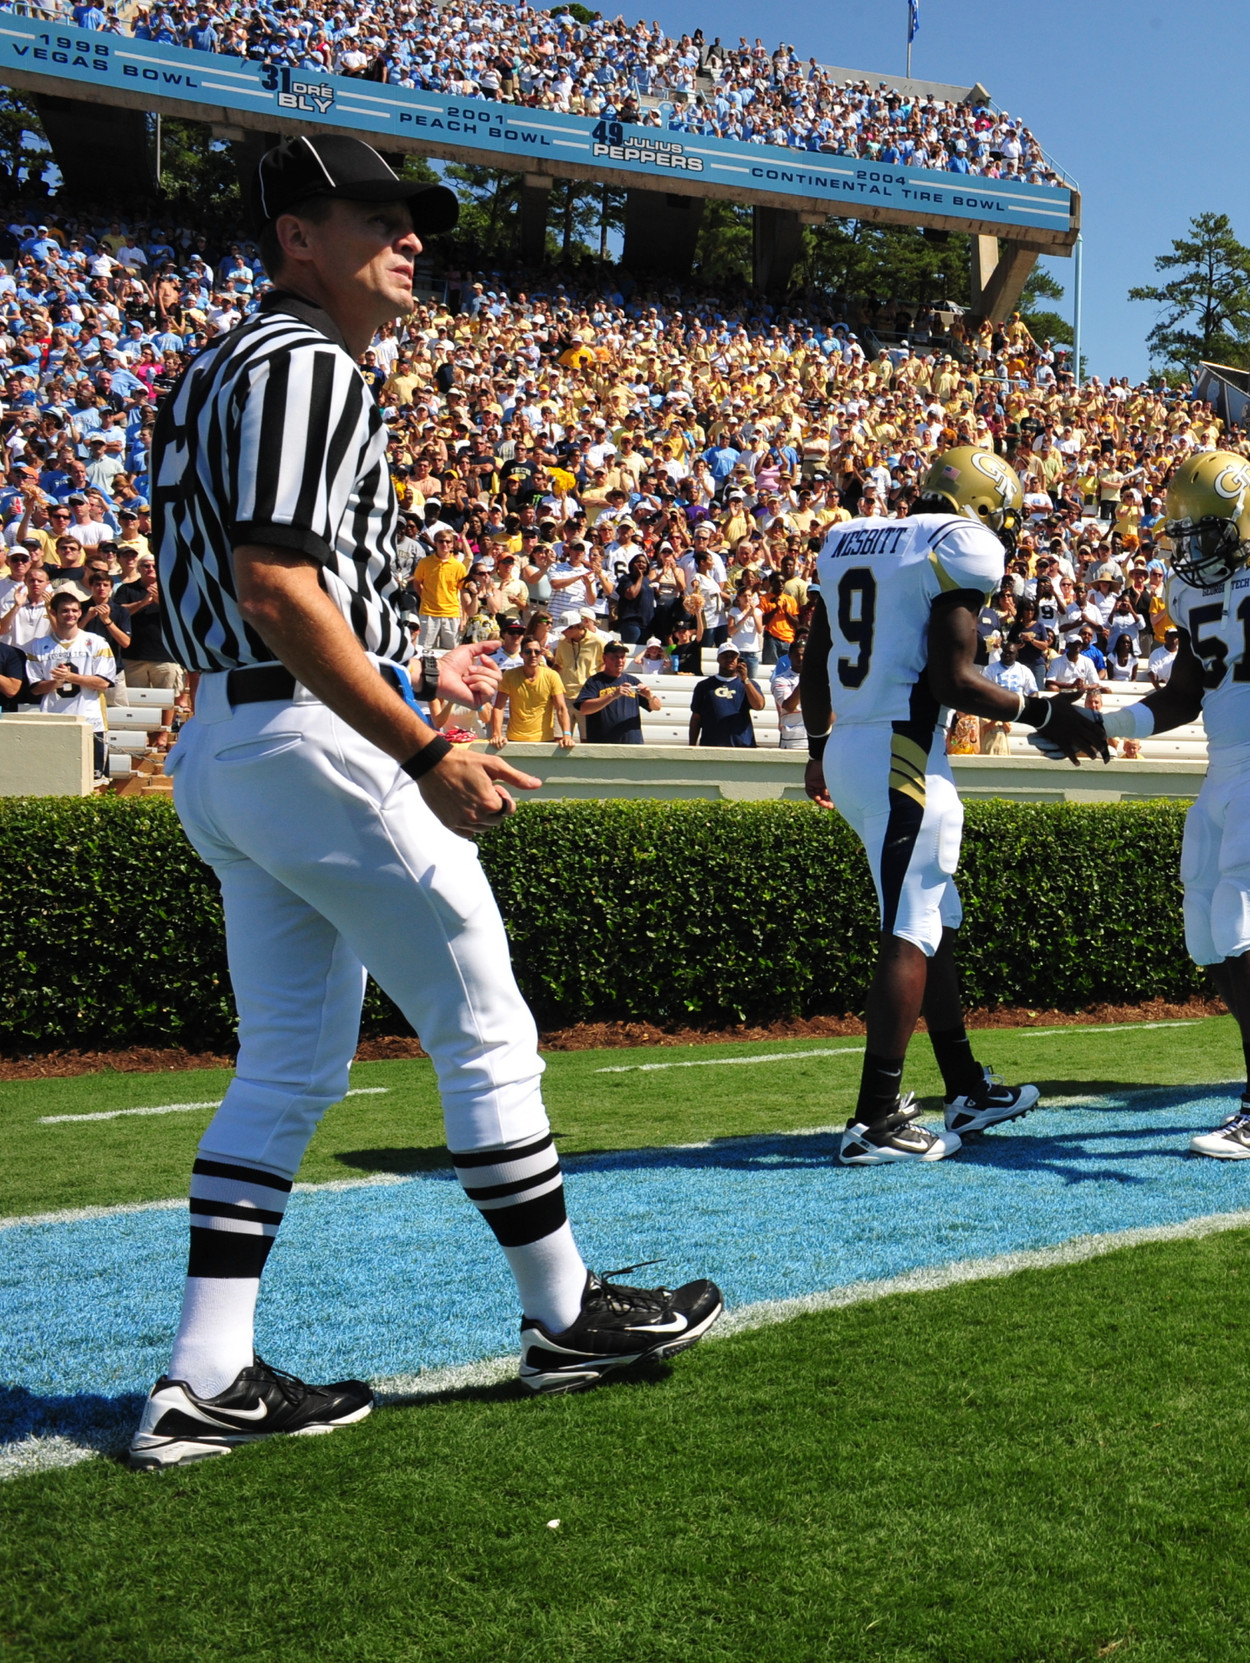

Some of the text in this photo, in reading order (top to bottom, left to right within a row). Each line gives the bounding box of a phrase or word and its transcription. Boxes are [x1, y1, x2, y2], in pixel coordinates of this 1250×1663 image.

[40, 34, 109, 56] 1998
[12, 43, 197, 88] VEGAS BOWL
[262, 64, 334, 98] 31 DRÉ
[278, 91, 335, 114] BLY
[447, 107, 503, 124] 2001
[400, 112, 550, 145] PEACH BOWL
[592, 121, 623, 146] 49
[593, 143, 703, 172] PEPPERS
[624, 136, 683, 154] JULIUS
[751, 167, 1005, 212] CONTINENTAL TIRE BOWL
[856, 170, 906, 186] 2004
[831, 527, 908, 558] NESBITT
[1202, 578, 1250, 597] GEORGI TECH
[1041, 605, 1054, 619] 9
[838, 566, 877, 690] 9
